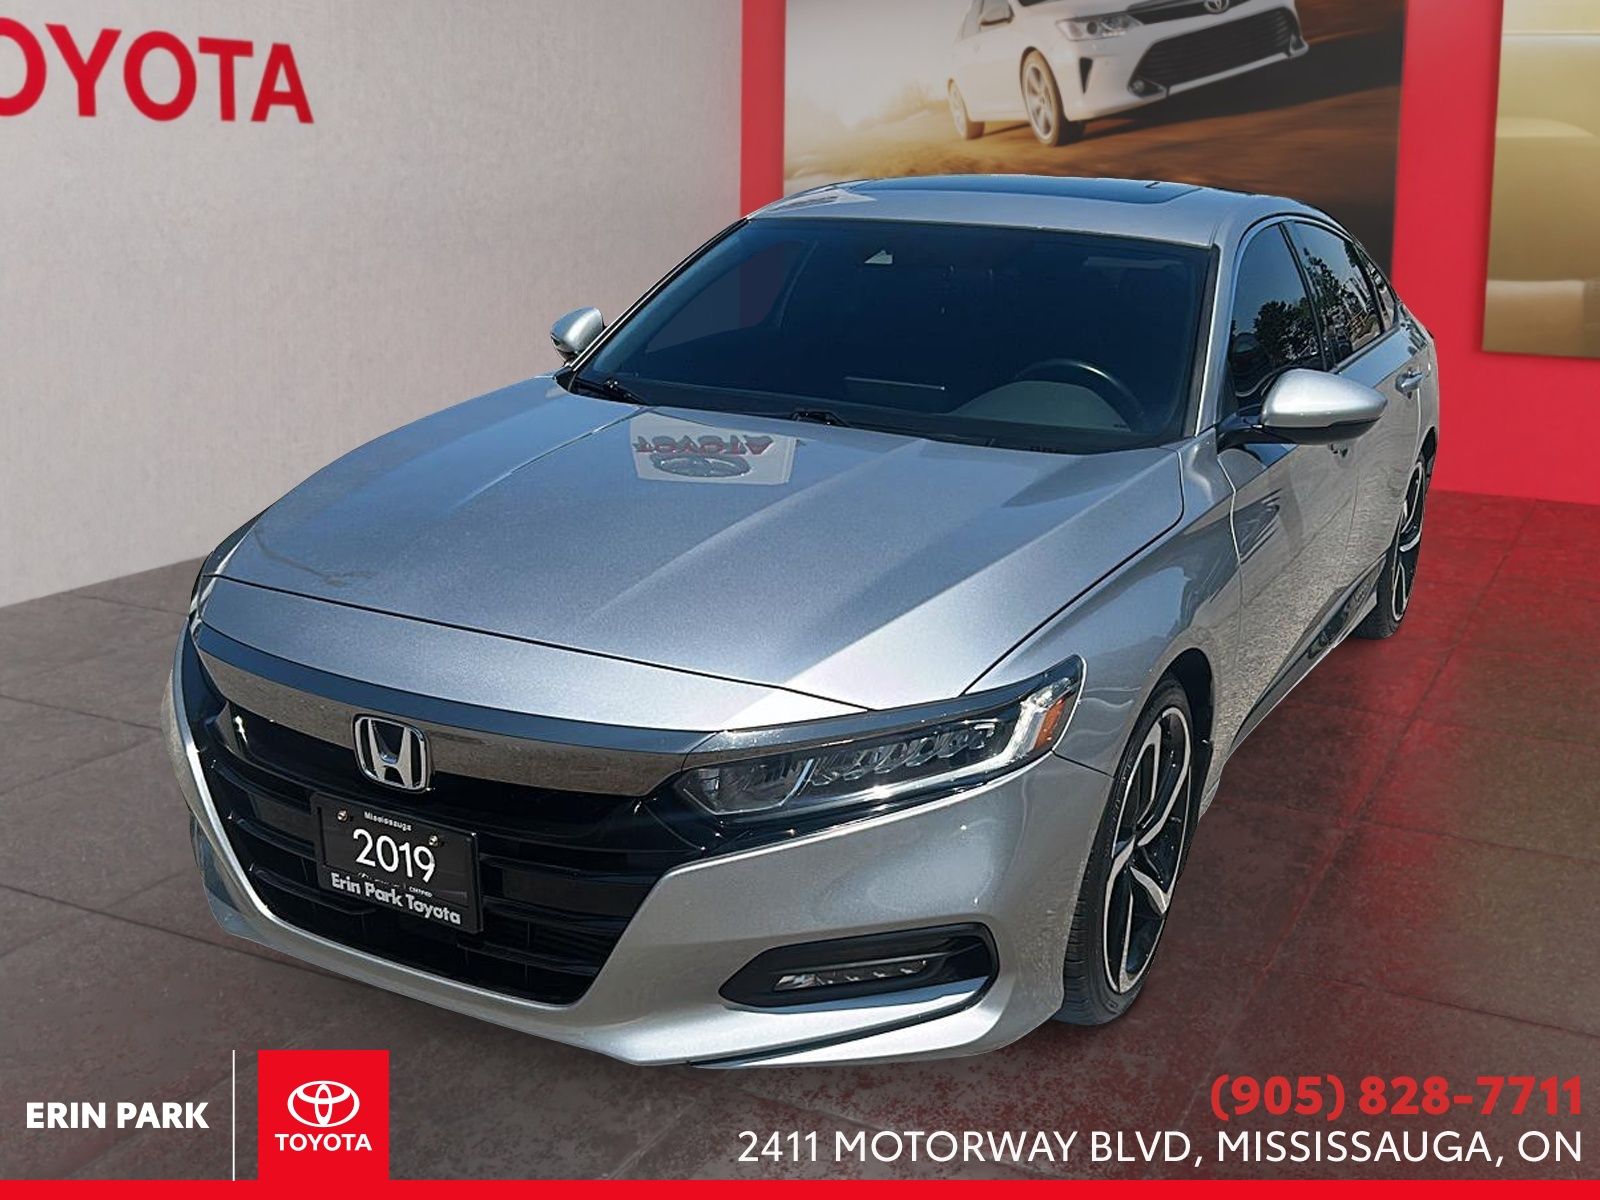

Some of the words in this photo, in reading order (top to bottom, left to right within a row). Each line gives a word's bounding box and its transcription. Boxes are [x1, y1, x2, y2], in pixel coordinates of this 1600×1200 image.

[364, 811, 412, 832] Mississauga
[352, 828, 436, 884] 2019
[331, 872, 361, 895] Erin
[364, 881, 403, 907] Park
[405, 893, 461, 925] Toyota
